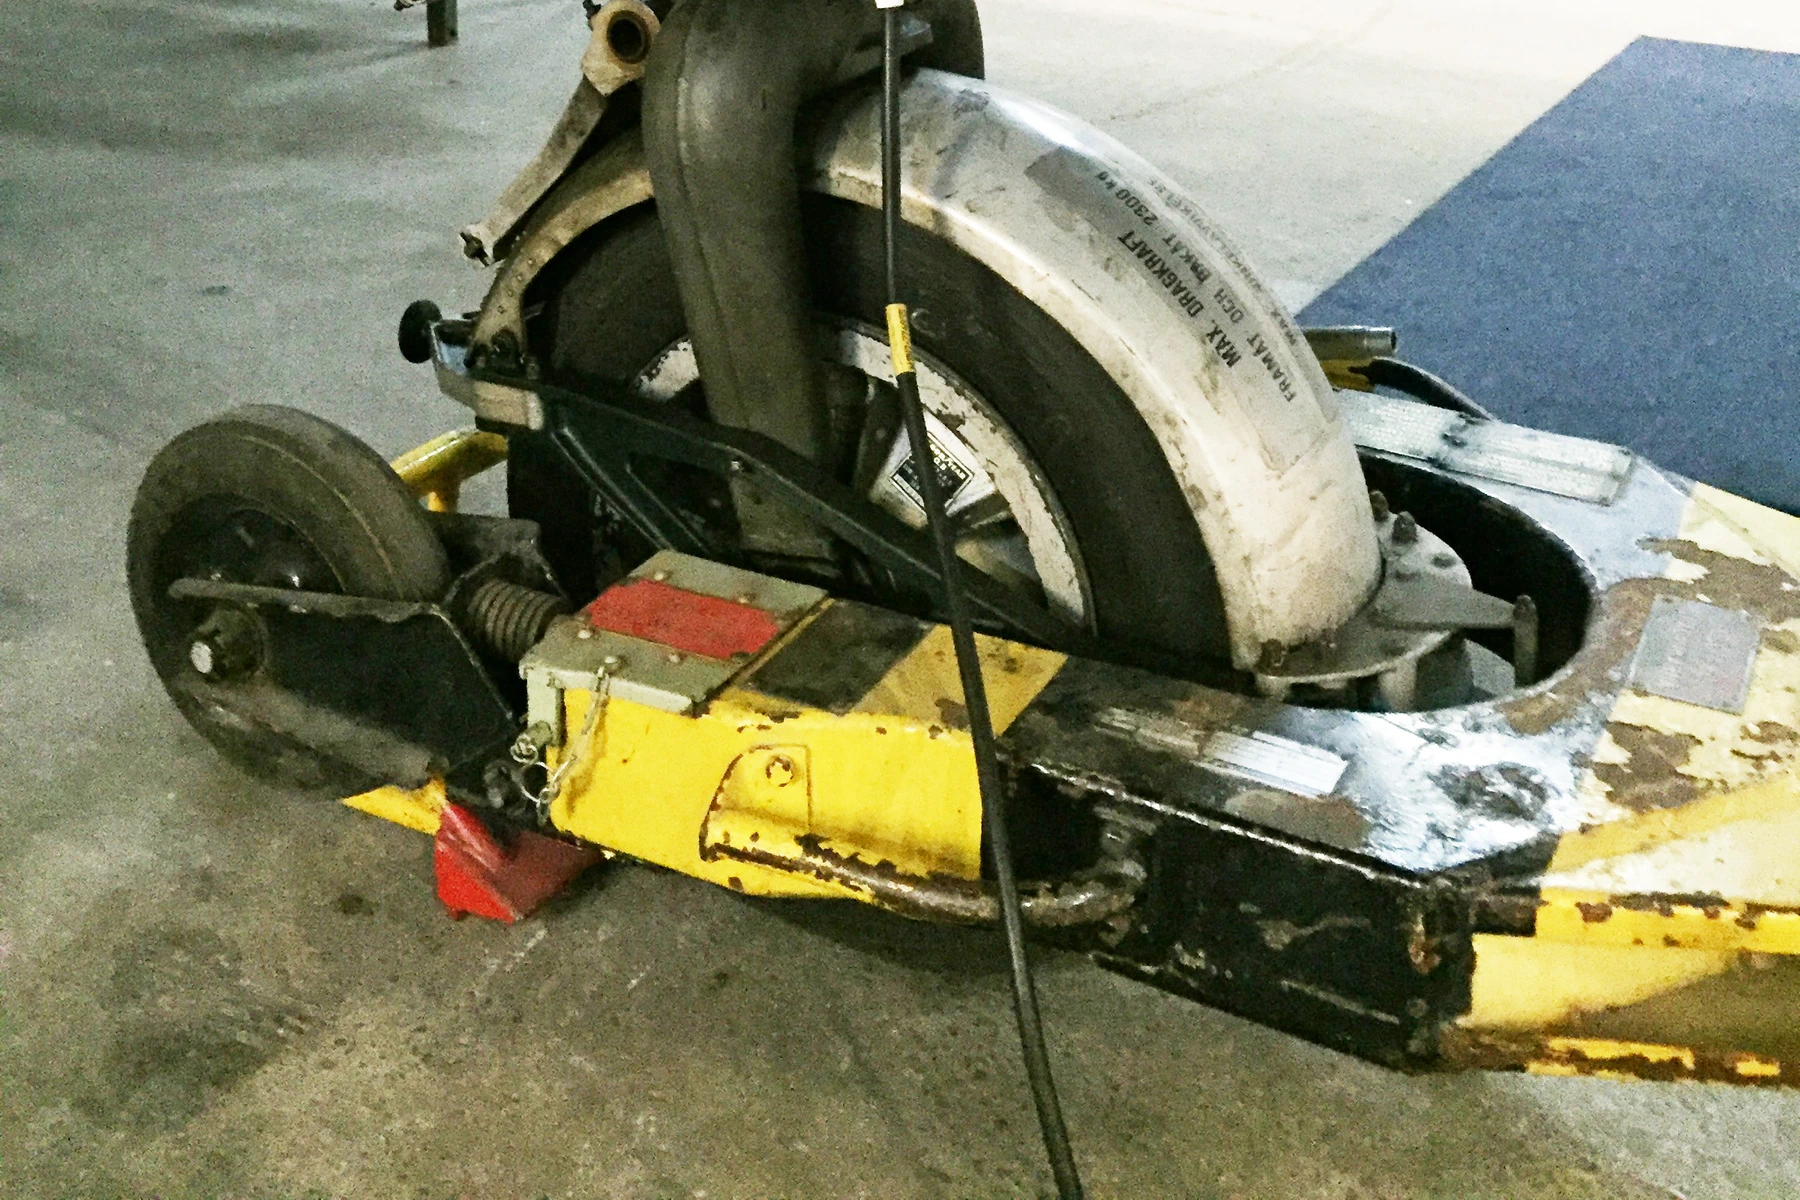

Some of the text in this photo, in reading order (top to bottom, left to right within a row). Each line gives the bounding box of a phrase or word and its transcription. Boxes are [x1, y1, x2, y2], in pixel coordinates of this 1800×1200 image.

[1095, 171, 1296, 403] FRAMÅT OCH BAKÅT 2300 kg
[1116, 228, 1242, 369] MAX. DRAGKRAFT
